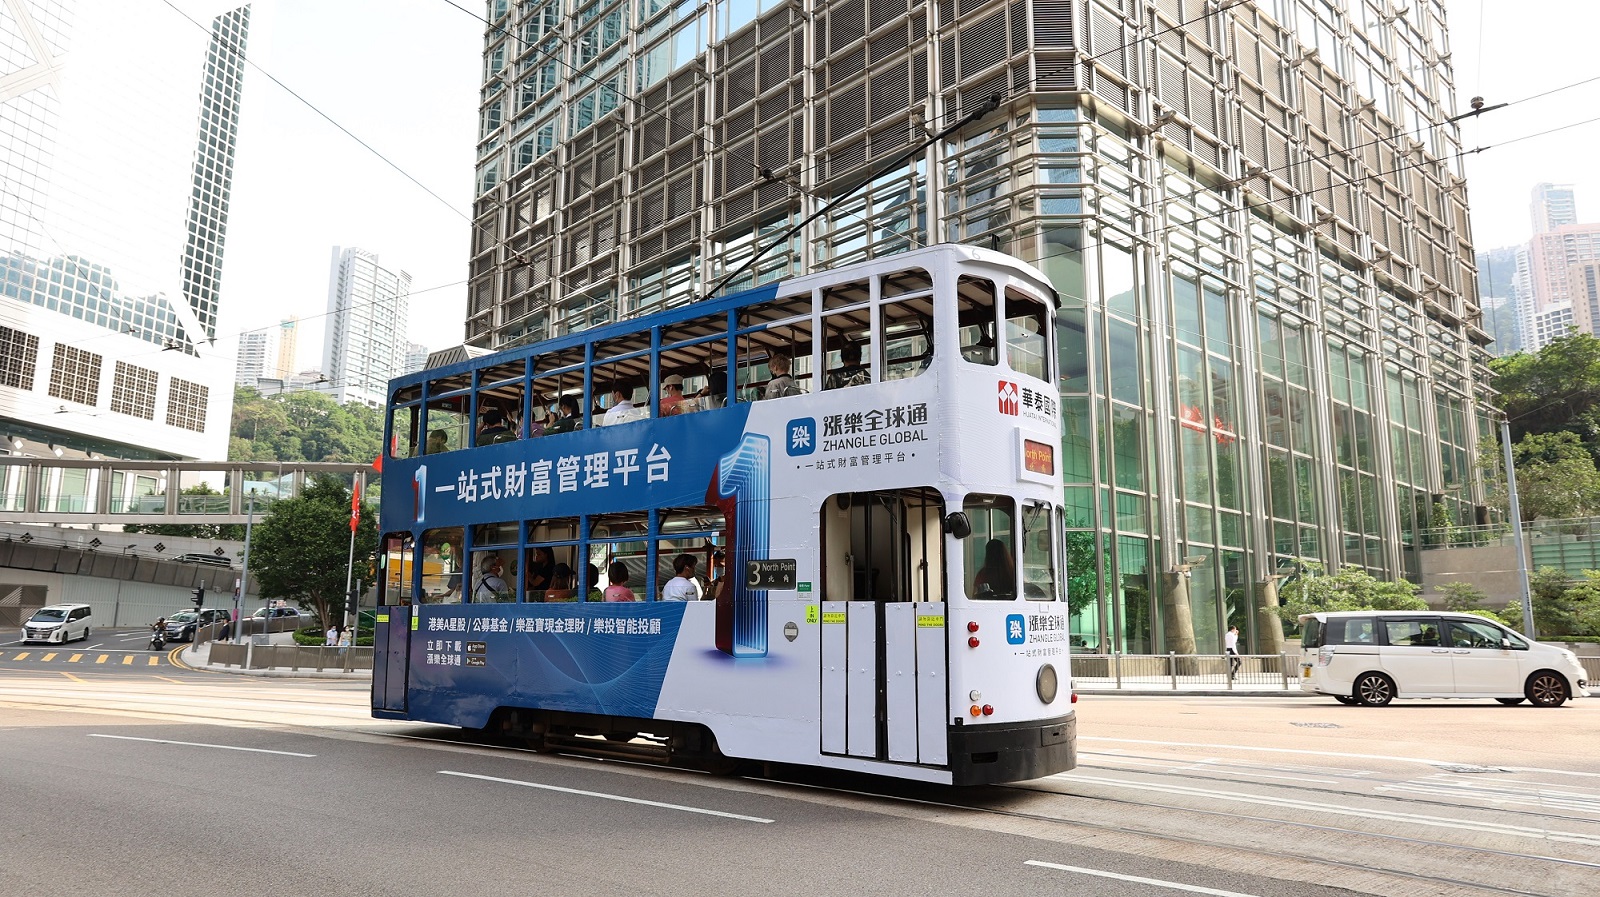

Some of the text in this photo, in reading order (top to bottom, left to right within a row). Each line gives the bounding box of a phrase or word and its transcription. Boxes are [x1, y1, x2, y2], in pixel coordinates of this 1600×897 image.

[822, 402, 928, 437] 漲樂全球通
[822, 429, 929, 452] ZHANGLE GLOBAL
[1025, 449, 1038, 460] orth
[434, 442, 672, 504] 一站式財富管理平台
[748, 561, 761, 586] 3
[762, 562, 796, 572] North Point
[767, 574, 790, 583] 北角
[428, 617, 467, 632] 港美A星股
[473, 617, 508, 633] 公募基金
[593, 617, 661, 635] 樂投智能投顧
[427, 640, 462, 652] 立即下載
[426, 653, 461, 666] 漲樂全球通
